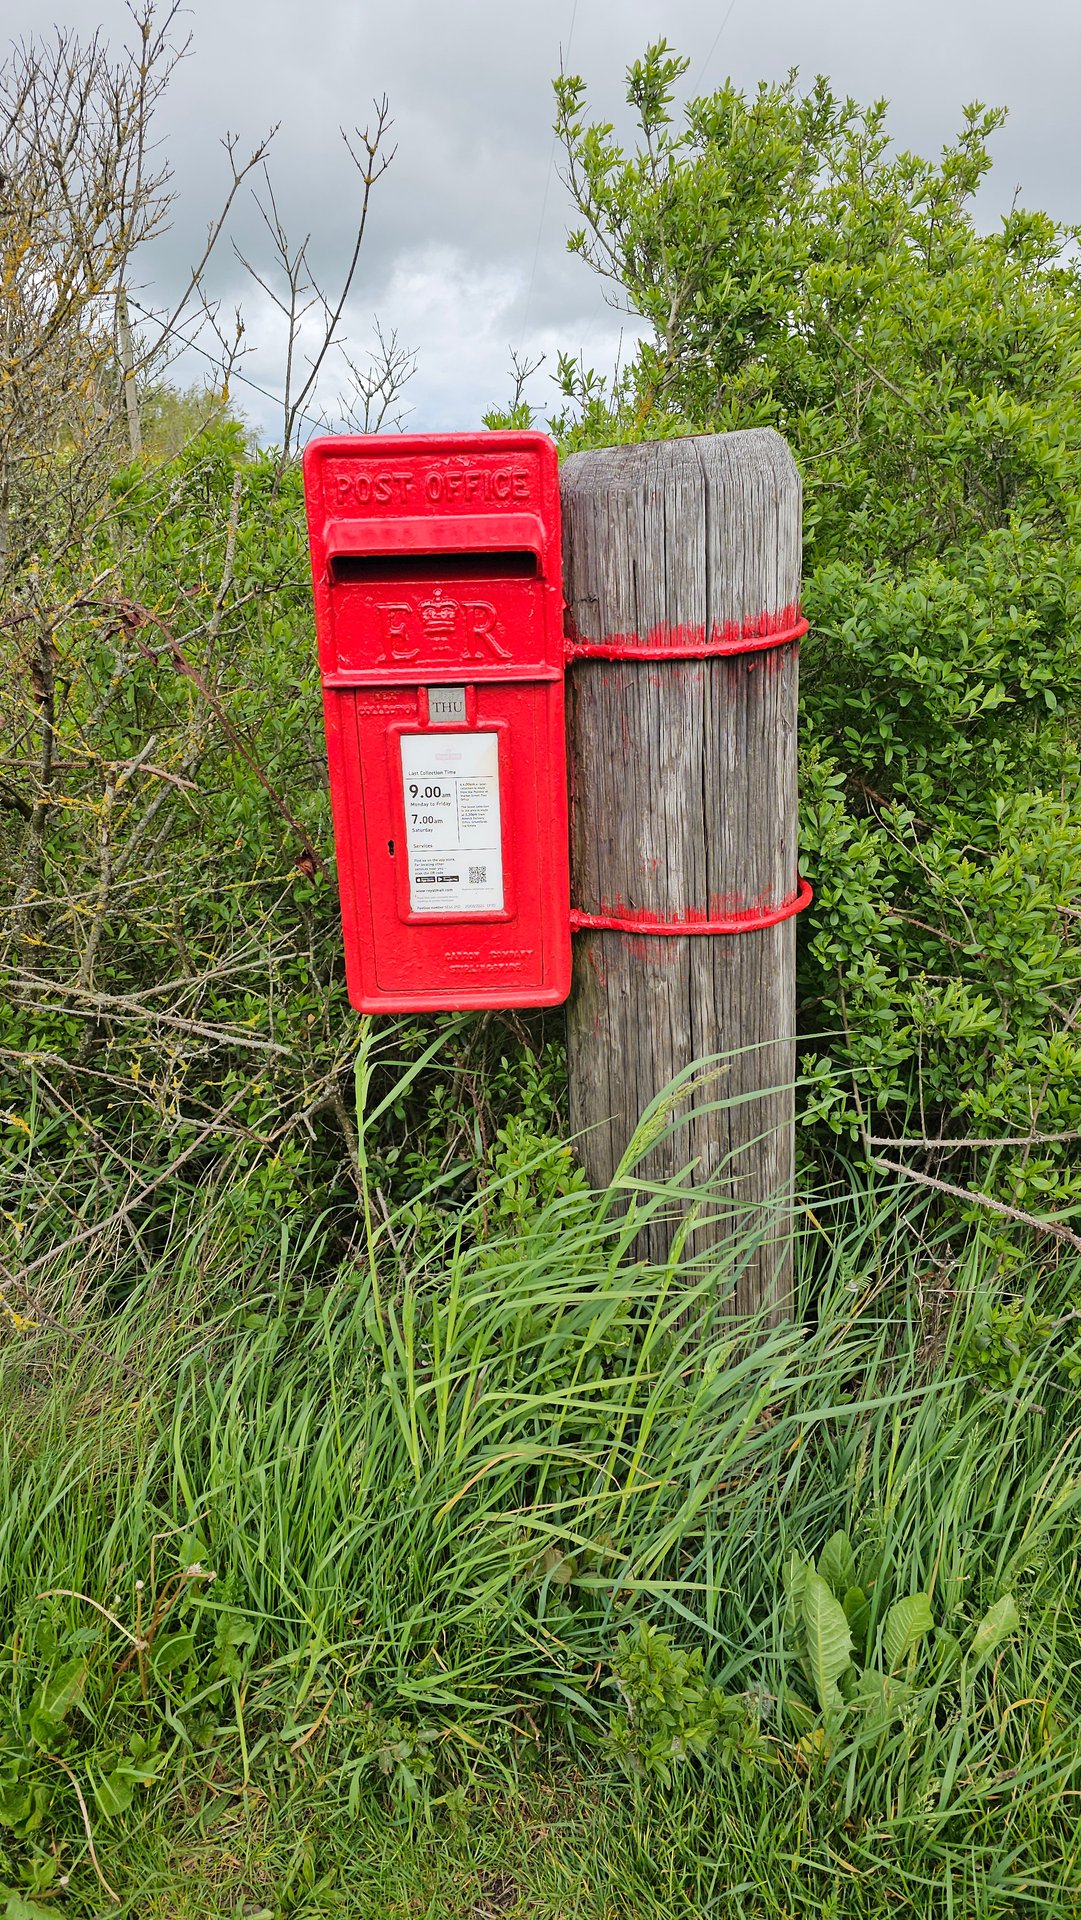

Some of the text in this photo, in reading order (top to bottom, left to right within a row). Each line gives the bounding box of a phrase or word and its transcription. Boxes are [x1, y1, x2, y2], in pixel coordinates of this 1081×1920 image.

[334, 468, 531, 505] POST OFFICE
[375, 600, 513, 663] E R
[432, 701, 463, 713] THU
